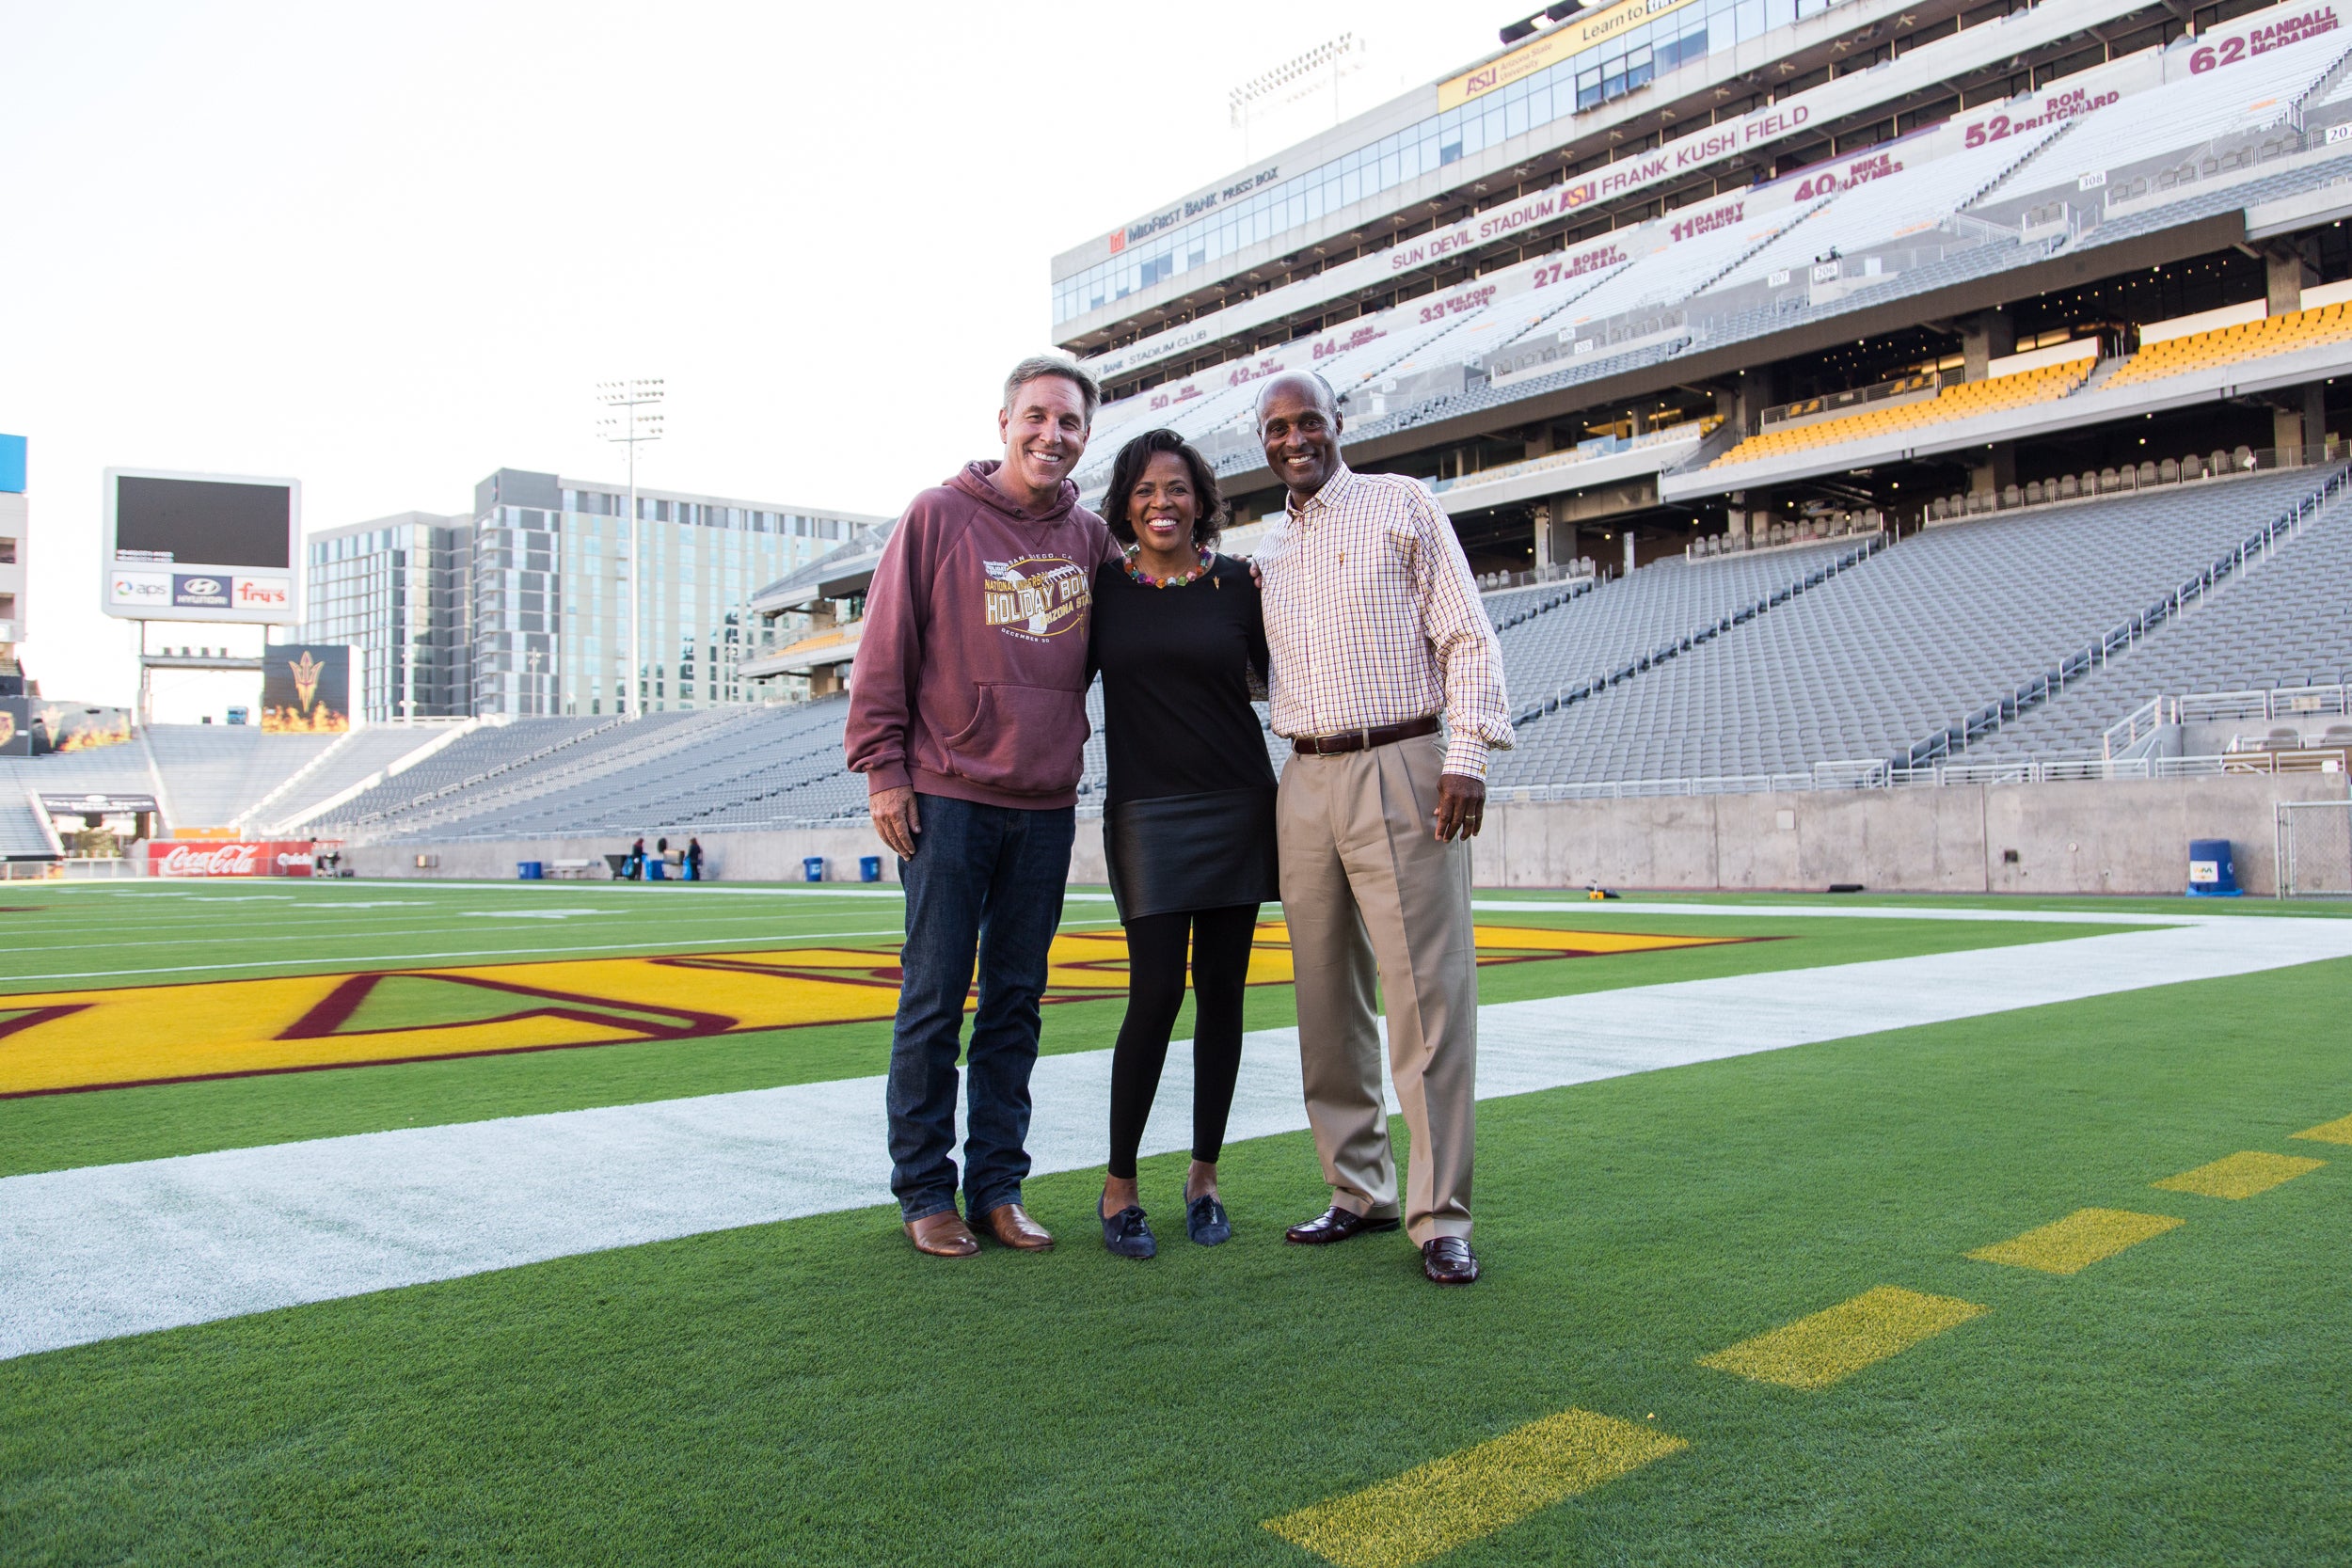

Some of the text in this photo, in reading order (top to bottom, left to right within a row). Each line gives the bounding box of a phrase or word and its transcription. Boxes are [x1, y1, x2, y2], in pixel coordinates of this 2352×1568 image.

[1582, 13, 1625, 40] Learn
[1628, 7, 1644, 22] to
[2250, 6, 2337, 45] RANDALL
[2250, 19, 2340, 56] McDANIEL
[1502, 43, 1552, 70] Arizona State
[2189, 37, 2246, 75] 62
[1466, 67, 1497, 96] ASU
[1501, 60, 1538, 81] University
[2046, 87, 2086, 111] RON
[2014, 90, 2120, 135] PRITCHARD
[1964, 115, 2011, 149] 52
[1851, 153, 1889, 176] MIKE
[1223, 178, 1253, 201] PRESS
[1255, 166, 1279, 186] BOX
[1391, 105, 1808, 270] SUN DEVIL STADIUM ASU FRANK KUSH FIELD
[1794, 173, 1836, 202] 40
[2085, 173, 2104, 186] 308
[1695, 200, 1745, 227] DANNY
[1671, 219, 1693, 243] 11
[1573, 244, 1617, 267] BOBBY
[1534, 262, 1562, 290] 27
[1817, 266, 1836, 277] 206
[1446, 285, 1497, 309] WILFORD
[1420, 302, 1445, 325] 33
[1129, 341, 1174, 365] STADIUM
[1177, 329, 1207, 347] CLUB
[1312, 338, 1336, 360] 84
[1229, 367, 1250, 387] 42
[1150, 393, 1168, 411] 50
[1008, 555, 1025, 566] SAN
[135, 582, 167, 597] aps
[177, 595, 228, 606] HYUNDAI
[237, 582, 285, 603] fry's
[985, 579, 1016, 591] NATIONAL
[985, 582, 1054, 626] HOLIDAY
[1040, 600, 1074, 626] ARIZONA
[1001, 627, 1039, 642] DECEMBER
